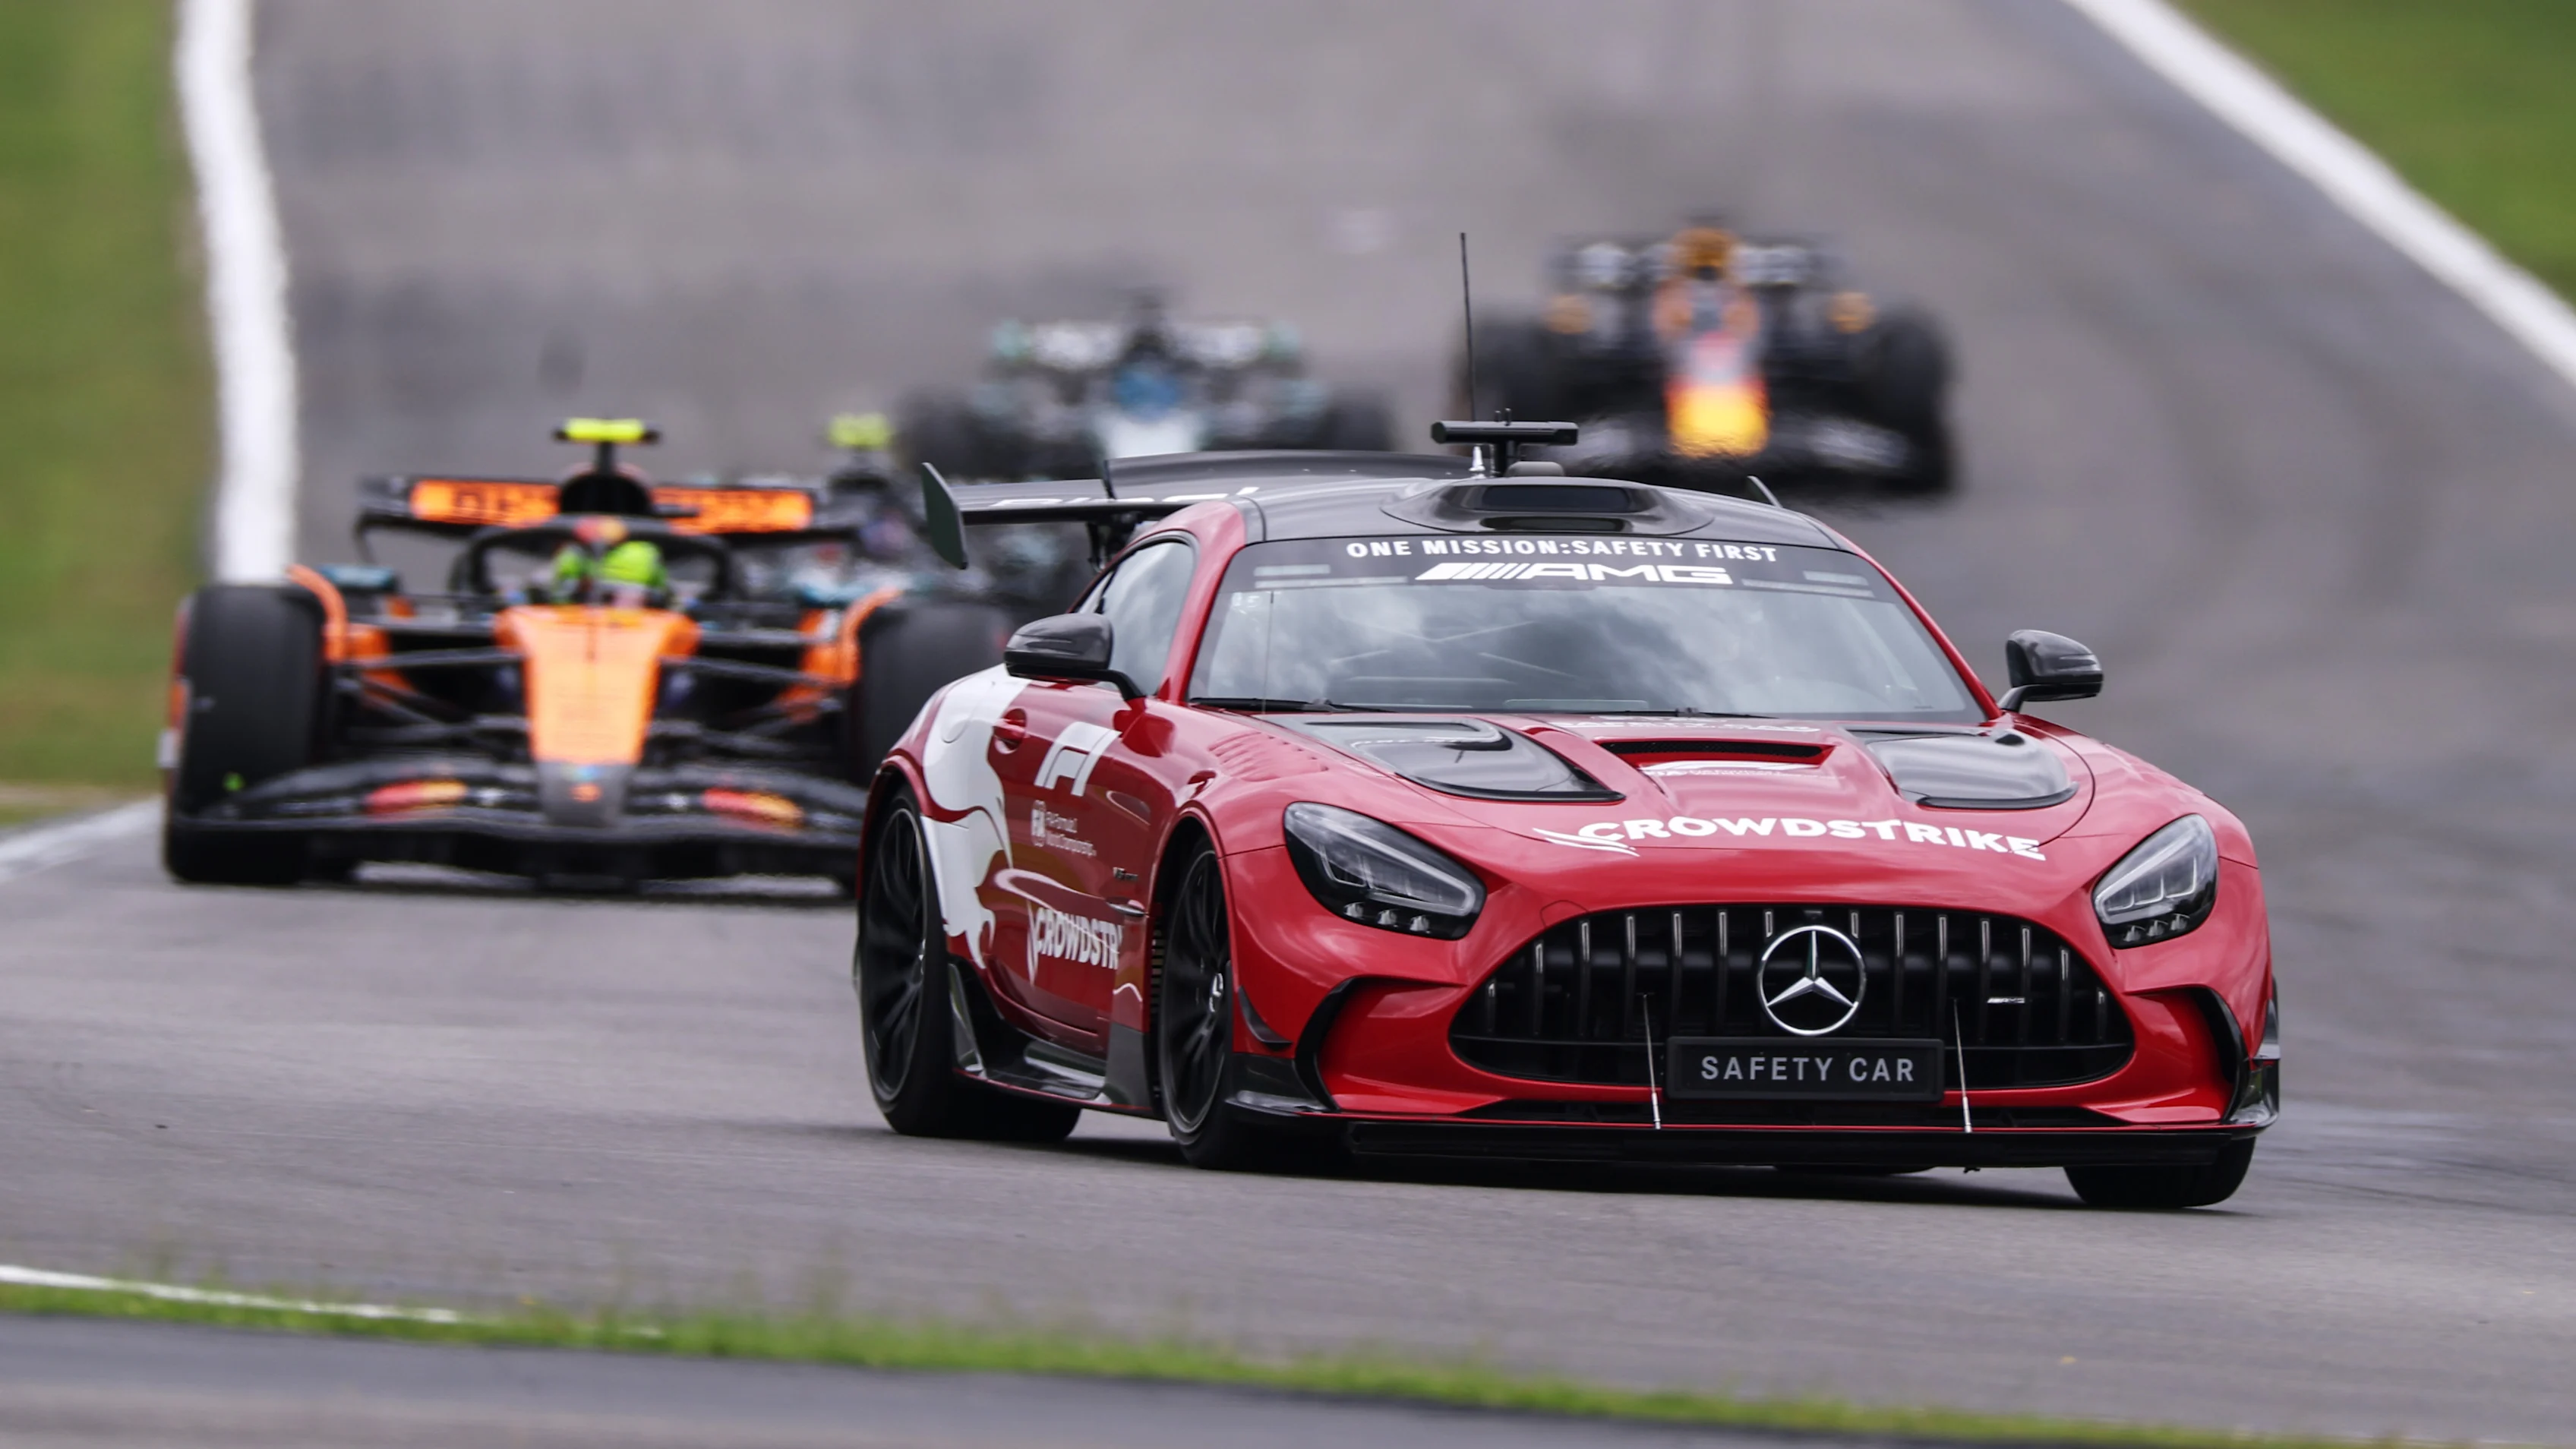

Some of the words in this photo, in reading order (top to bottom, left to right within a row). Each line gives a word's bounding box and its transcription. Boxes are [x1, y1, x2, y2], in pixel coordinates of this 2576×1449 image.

[1346, 541, 1412, 557] ONE
[1694, 544, 1777, 562] FIRST
[1515, 563, 1733, 584] AMG
[1578, 816, 2046, 860] CROWDSTRIKE
[1701, 1056, 1833, 1081] SAFETY
[1848, 1058, 1914, 1081] CAR
